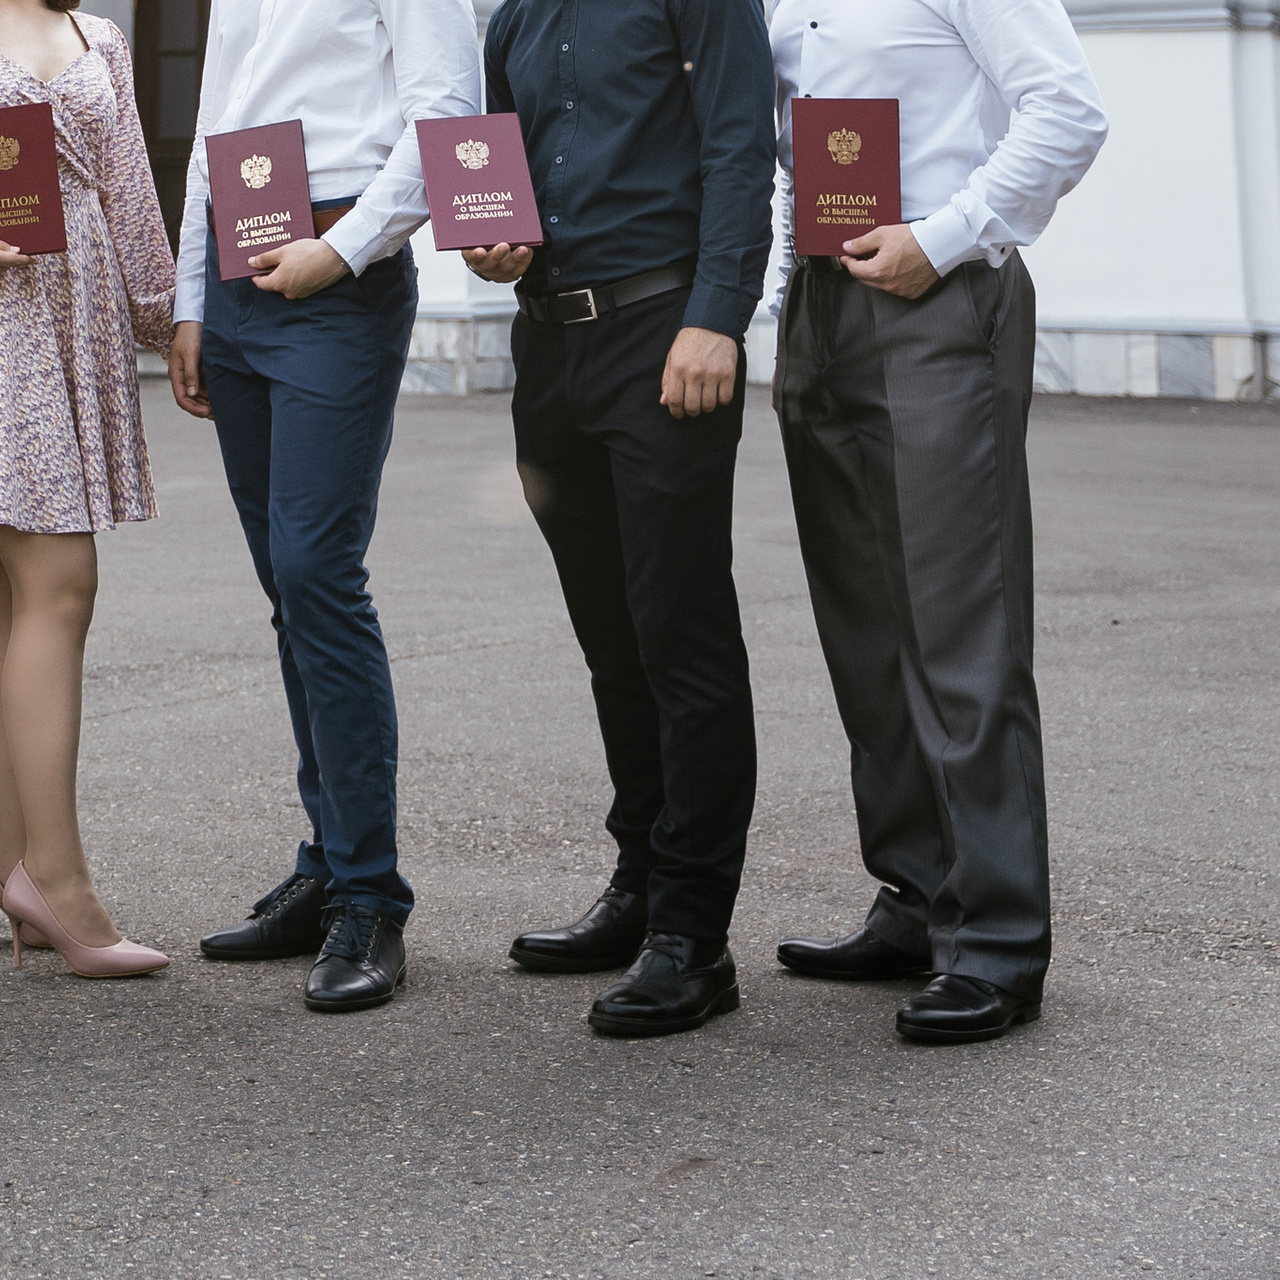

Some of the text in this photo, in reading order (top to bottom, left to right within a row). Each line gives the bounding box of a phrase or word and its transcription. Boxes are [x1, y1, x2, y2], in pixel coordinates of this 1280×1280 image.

[452, 191, 513, 207] ДИПЛОМ
[816, 194, 877, 206] ДИПЛОМ
[469, 203, 506, 212] ВЫСШЕМ
[832, 208, 869, 216] ВЫСШЕМ
[235, 210, 292, 232] ДИПЛОМ
[454, 210, 514, 221] ОБРАЗОВАНИИ
[816, 216, 875, 225] ОБРАЗОВАНИИ
[242, 225, 284, 239] О ВЫСШЕМ
[237, 232, 291, 248] ОБРАЗОВАНИИ
